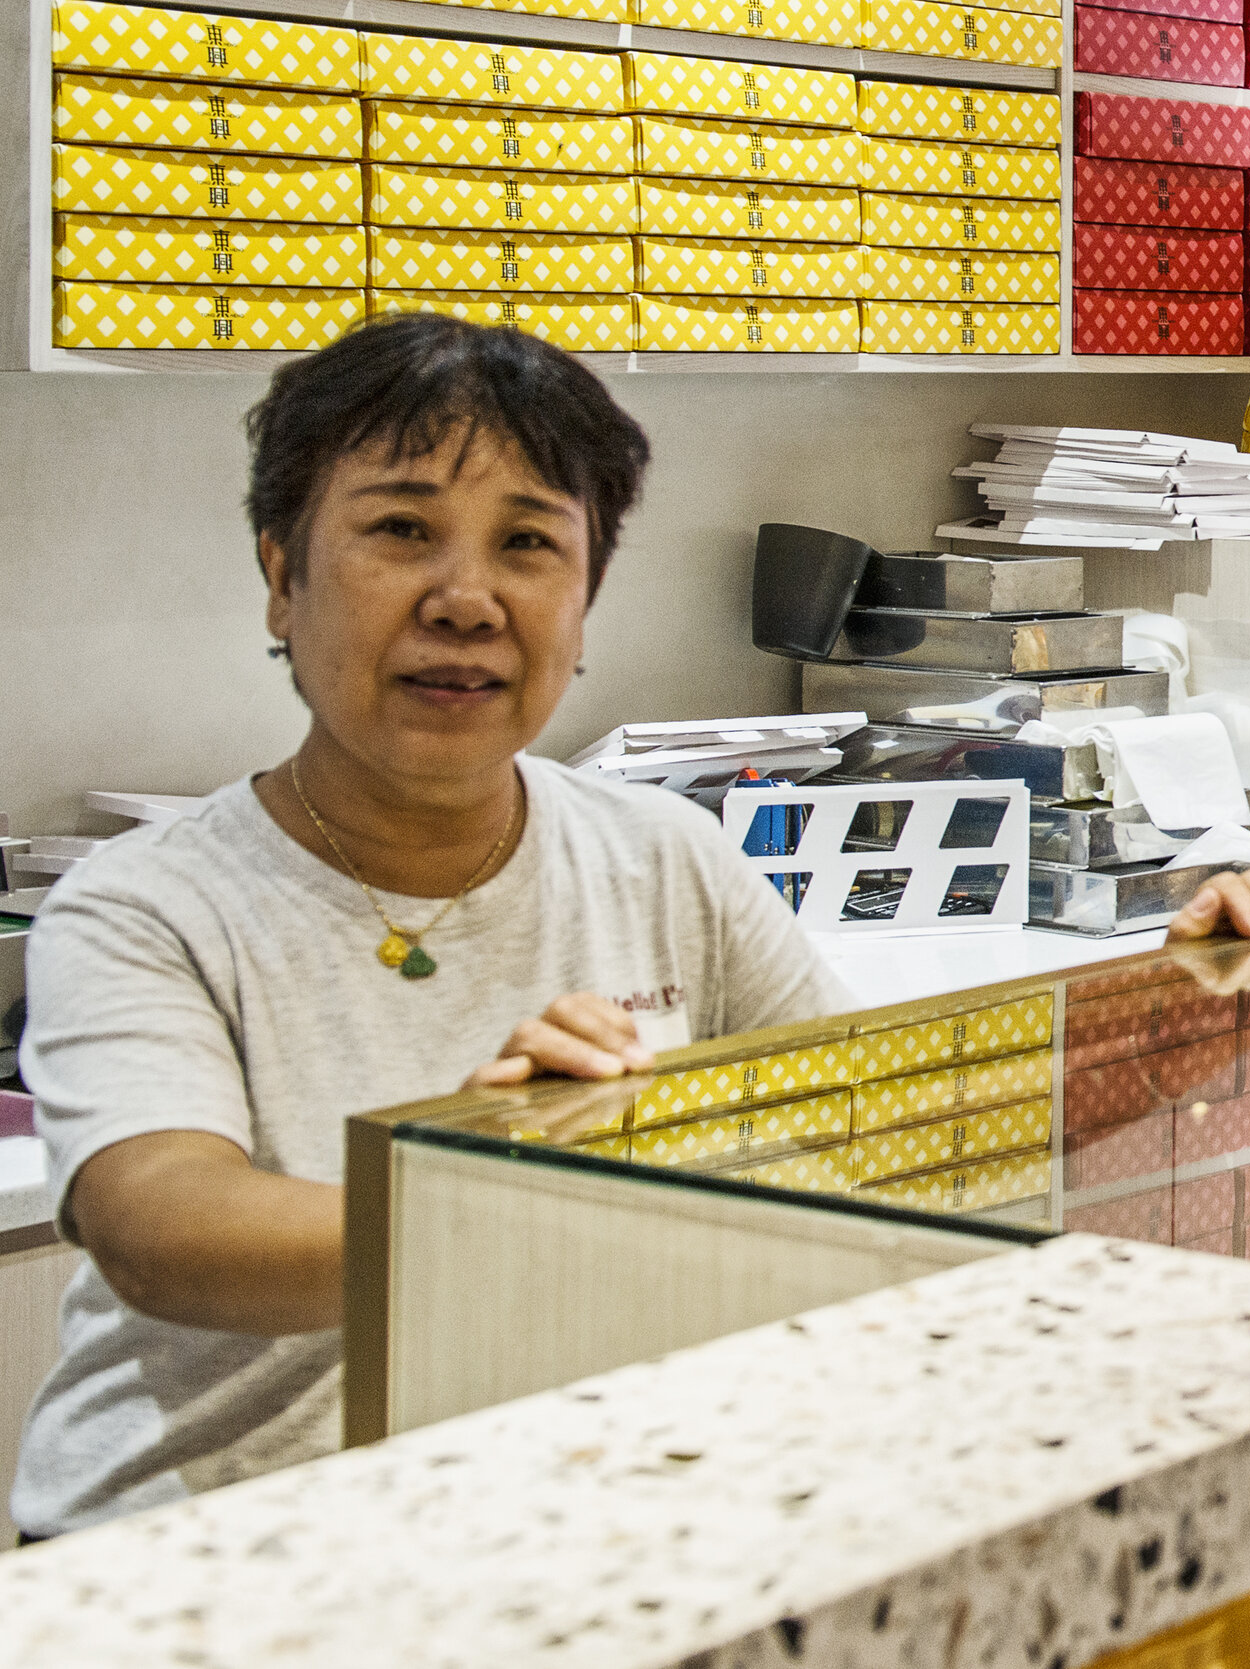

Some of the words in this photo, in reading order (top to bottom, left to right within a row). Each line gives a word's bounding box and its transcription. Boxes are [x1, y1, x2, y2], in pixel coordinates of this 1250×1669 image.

[205, 24, 228, 68] 東興
[490, 53, 510, 94] 東興
[207, 94, 231, 140] 東興
[501, 117, 520, 159] 東興
[208, 163, 230, 208] 東興
[503, 179, 523, 221] 東興
[212, 229, 234, 274] 東興
[500, 240, 519, 282] 東興
[213, 295, 234, 340] 東興
